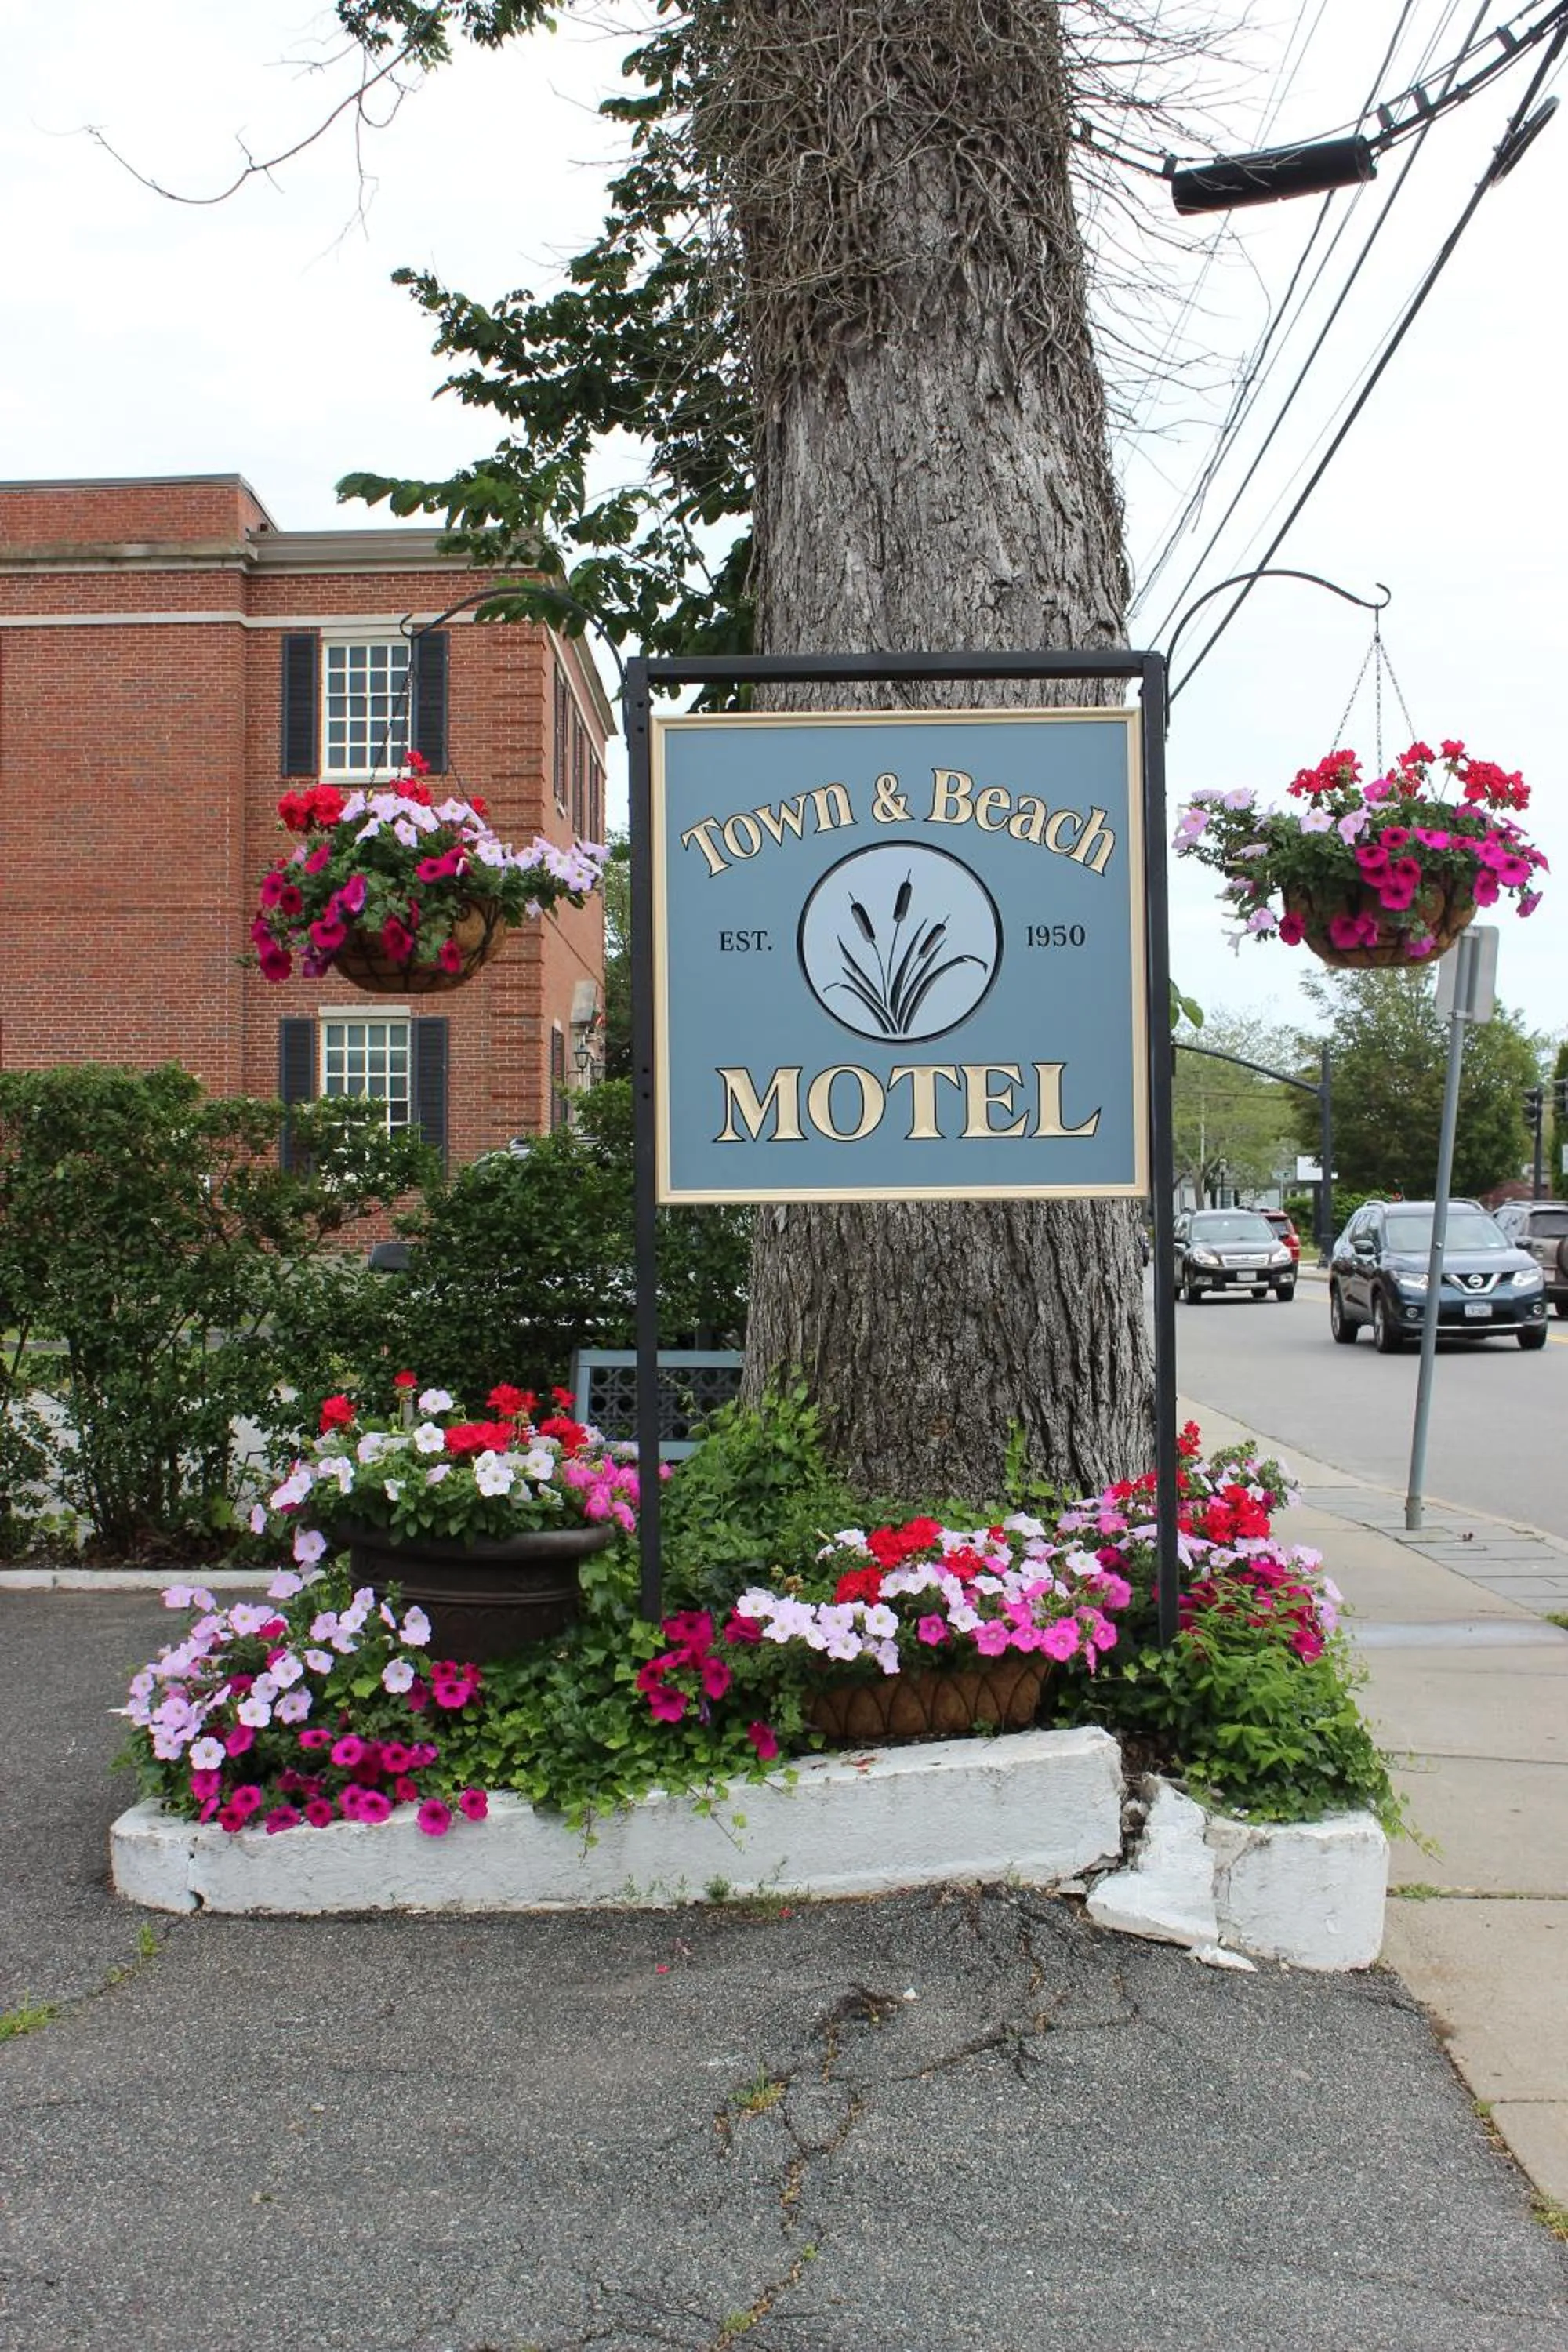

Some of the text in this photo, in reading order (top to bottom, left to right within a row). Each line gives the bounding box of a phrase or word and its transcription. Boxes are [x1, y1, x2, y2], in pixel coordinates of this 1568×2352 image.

[680, 767, 1116, 878] Town & Beach
[719, 924, 1087, 951] EST. 1950
[712, 1062, 1102, 1143] MOTEL
